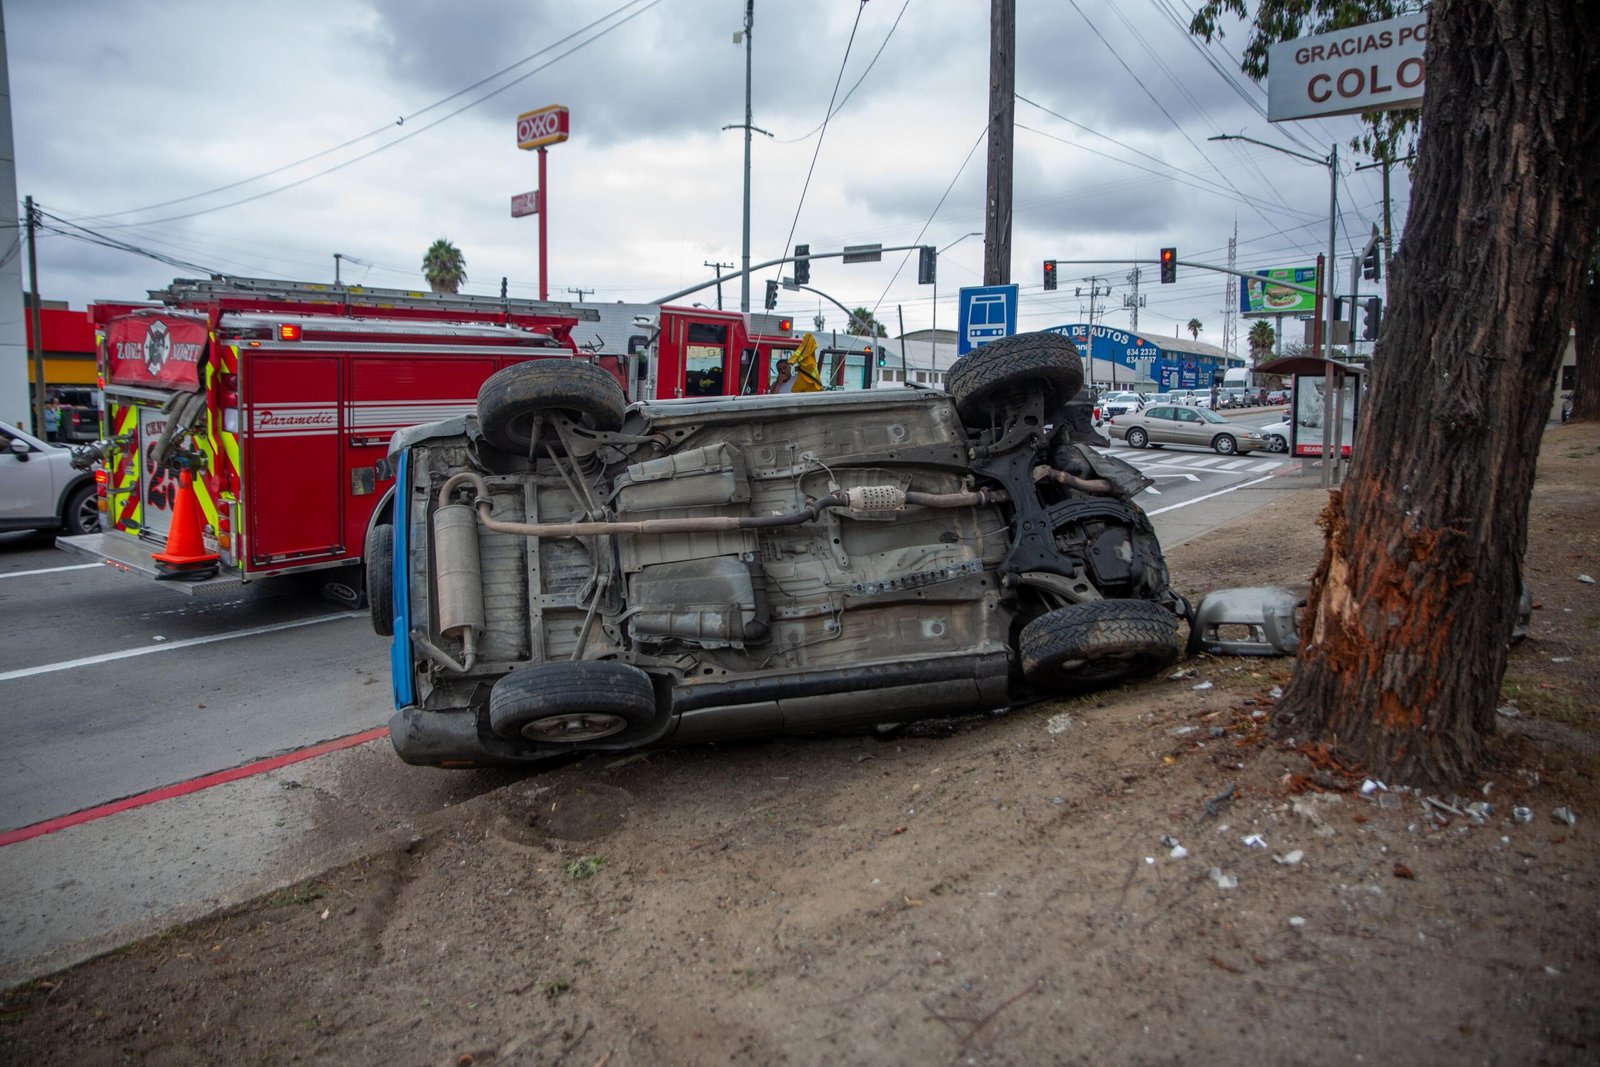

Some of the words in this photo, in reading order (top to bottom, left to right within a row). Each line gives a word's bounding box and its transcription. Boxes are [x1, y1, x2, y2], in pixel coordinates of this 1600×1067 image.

[1295, 31, 1393, 65] GRACIAS
[1307, 57, 1426, 103] COLO
[518, 112, 558, 141] OXXO
[1072, 326, 1086, 336] DE
[1091, 327, 1129, 345] AUTOS
[116, 342, 142, 360] ZONA
[170, 343, 201, 362] NORTE
[1126, 348, 1139, 356] 634
[1140, 348, 1157, 356] 2332
[259, 410, 332, 430] Paramedic
